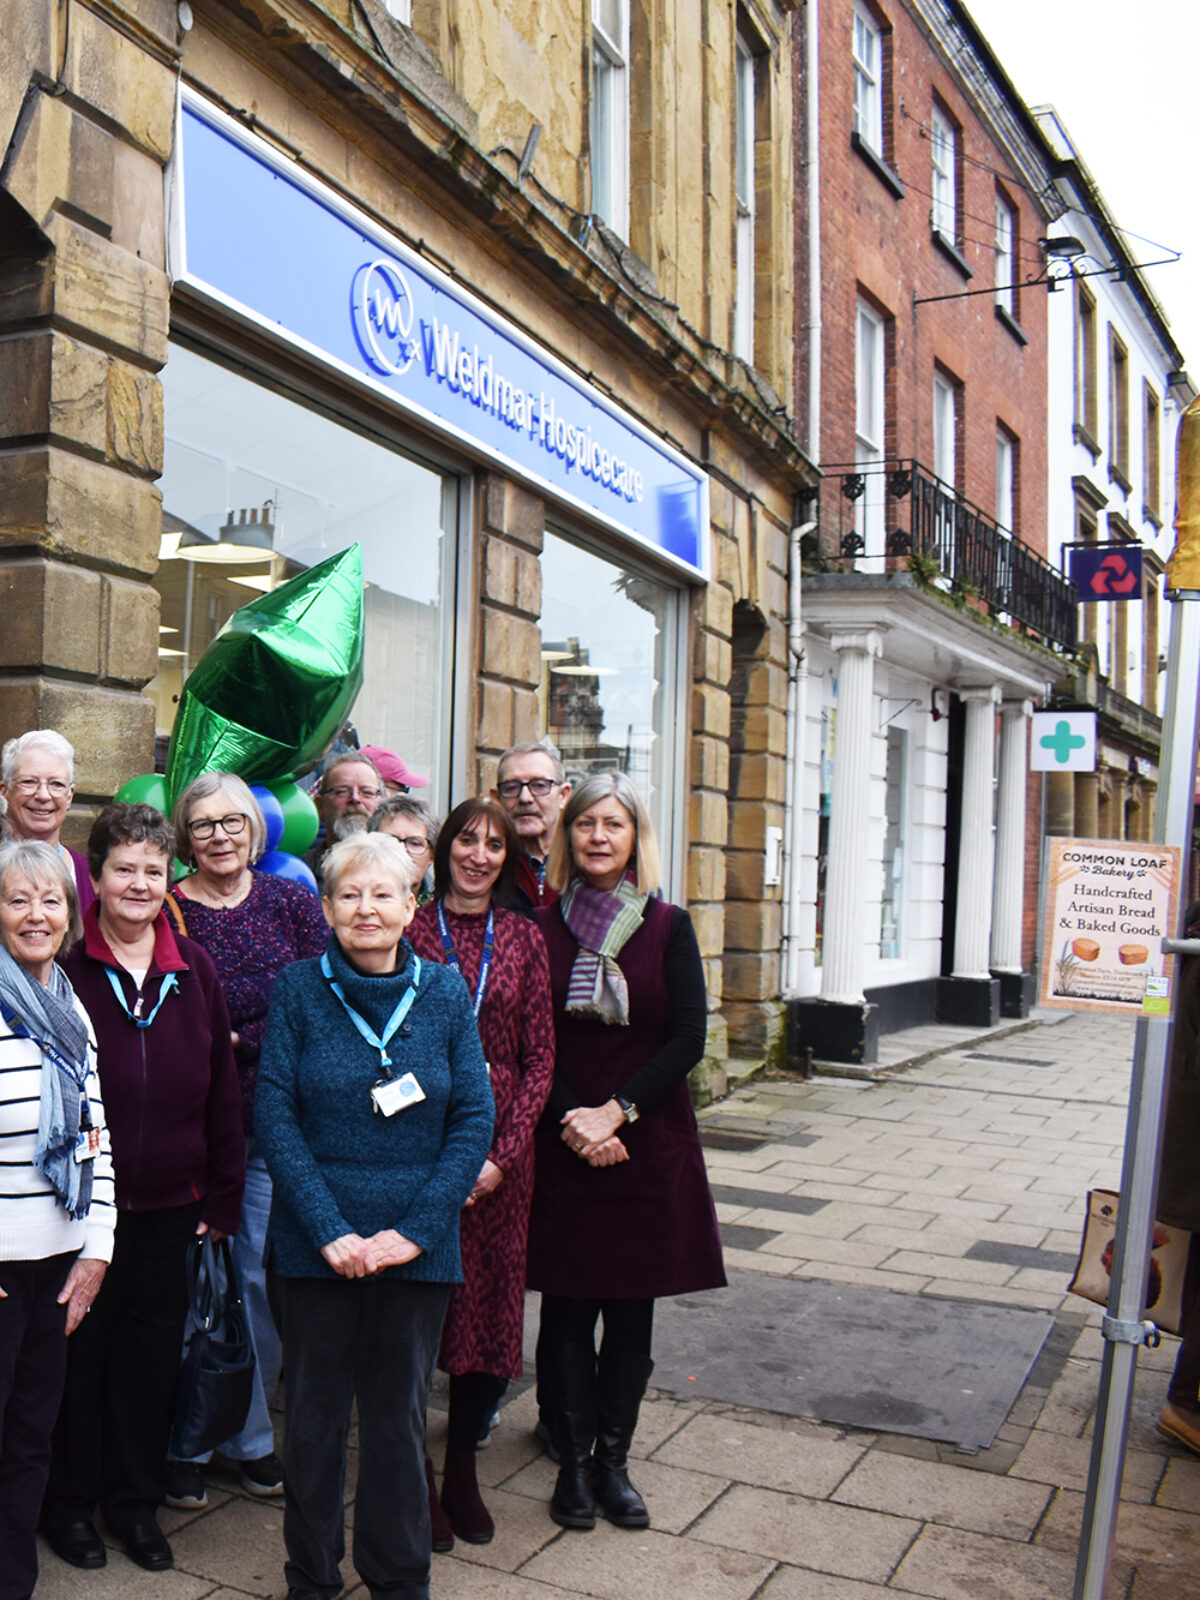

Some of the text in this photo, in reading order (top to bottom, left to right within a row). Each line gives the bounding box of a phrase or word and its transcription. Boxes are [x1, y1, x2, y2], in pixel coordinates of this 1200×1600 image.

[432, 316, 644, 502] Weldmar Hospicecare
[1062, 852, 1167, 869] COMMON LOAF
[1092, 865, 1134, 881] Bakery
[1073, 883, 1153, 900] Handcrafted
[1067, 901, 1155, 918] Artisan Bread
[1059, 917, 1161, 936] & Baked Goods
